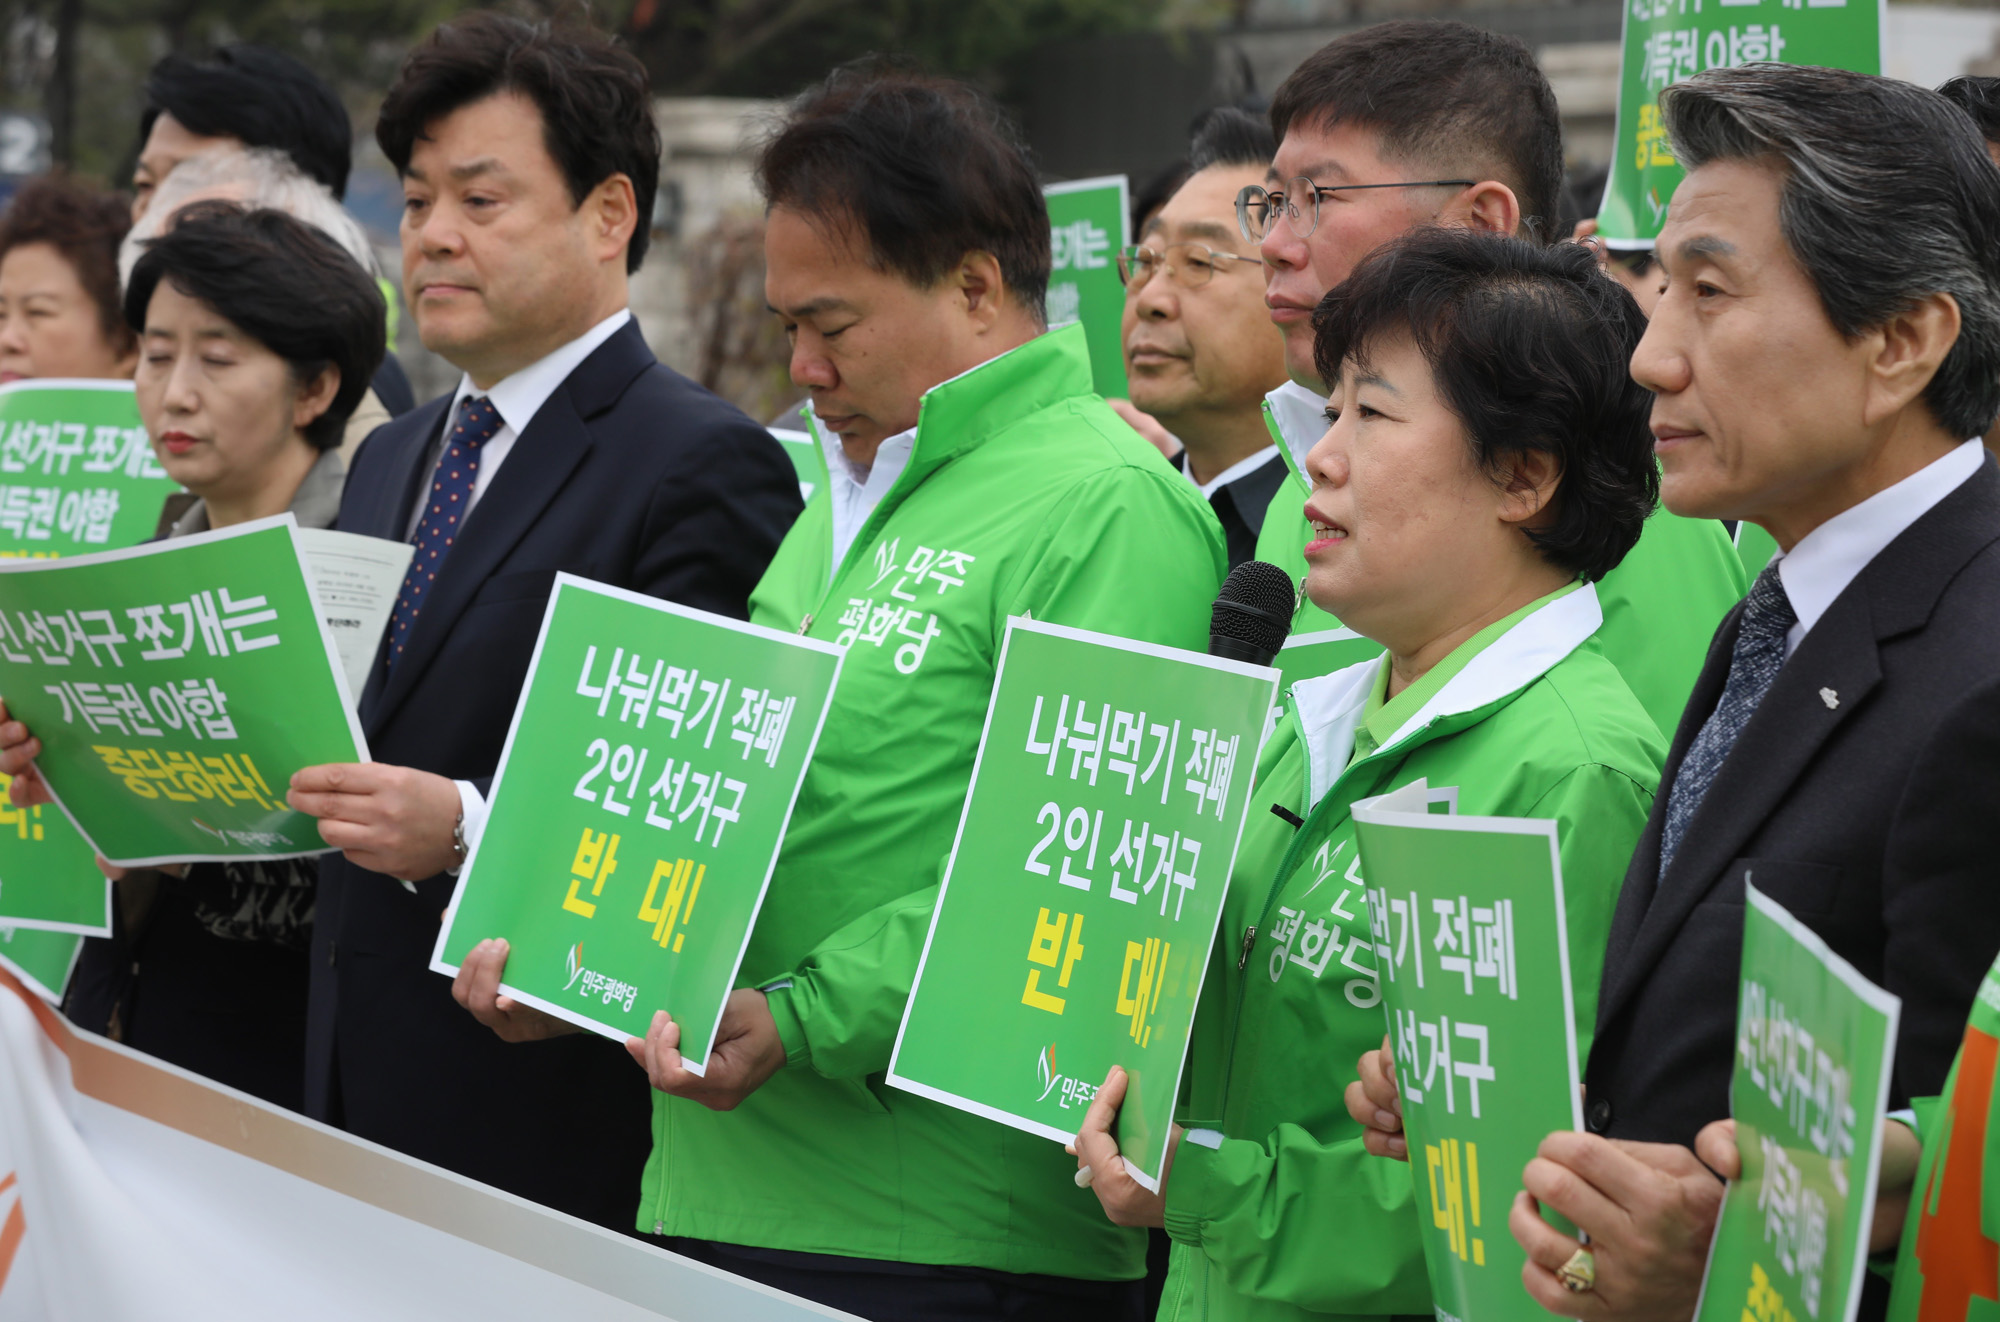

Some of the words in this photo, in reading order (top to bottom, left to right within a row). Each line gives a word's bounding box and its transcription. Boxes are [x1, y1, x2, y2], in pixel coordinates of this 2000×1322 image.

[58, 487, 120, 543] 야합
[125, 586, 281, 662] 쪼개는
[890, 545, 976, 602] 민주
[836, 598, 942, 675] 평화당
[44, 680, 165, 737] 기득권
[149, 678, 239, 740] 야합
[576, 644, 732, 750] 나눠먹기
[730, 686, 797, 769] 적폐
[1025, 693, 1181, 804] 나눠먹기
[1184, 727, 1241, 822] 적폐
[91, 743, 290, 811] 중단하라!
[573, 738, 649, 817] 2인
[644, 756, 748, 848] 선거구
[561, 826, 621, 920] 반
[636, 857, 707, 955] 대!
[1024, 801, 1104, 892] 2인
[1109, 818, 1203, 922] 선거구
[579, 969, 639, 1014] 민주평화당
[1020, 906, 1085, 1017] 반
[1431, 894, 1518, 1001] 적폐
[1395, 1008, 1496, 1119] 선거구
[1424, 1137, 1485, 1267] 대!
